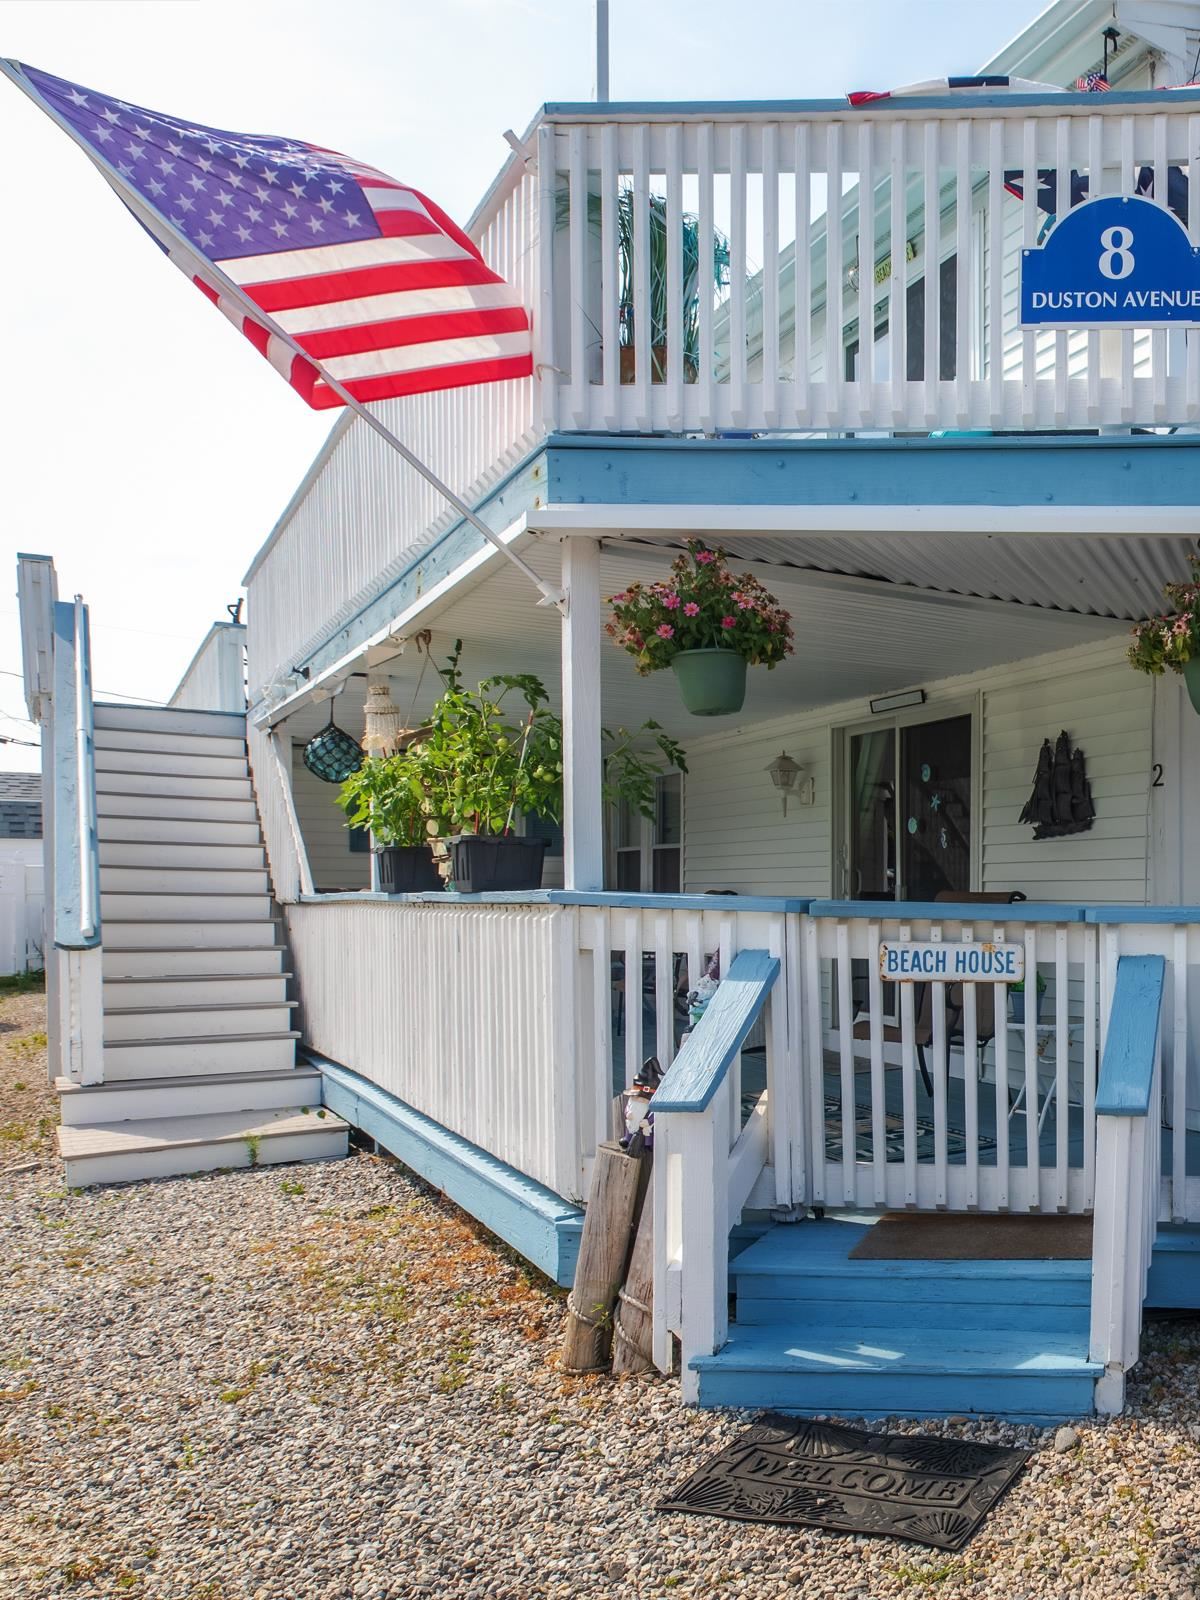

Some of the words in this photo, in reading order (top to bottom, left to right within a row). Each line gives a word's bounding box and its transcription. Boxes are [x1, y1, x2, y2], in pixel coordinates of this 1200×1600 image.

[1098, 225, 1135, 280] 8
[1031, 290, 1116, 309] DUSTON
[1122, 289, 1200, 308] AVENUE
[1152, 763, 1164, 787] 2
[887, 949, 947, 973] BEACH
[955, 950, 1016, 974] HOUSE
[747, 1455, 965, 1501] WELCOME
